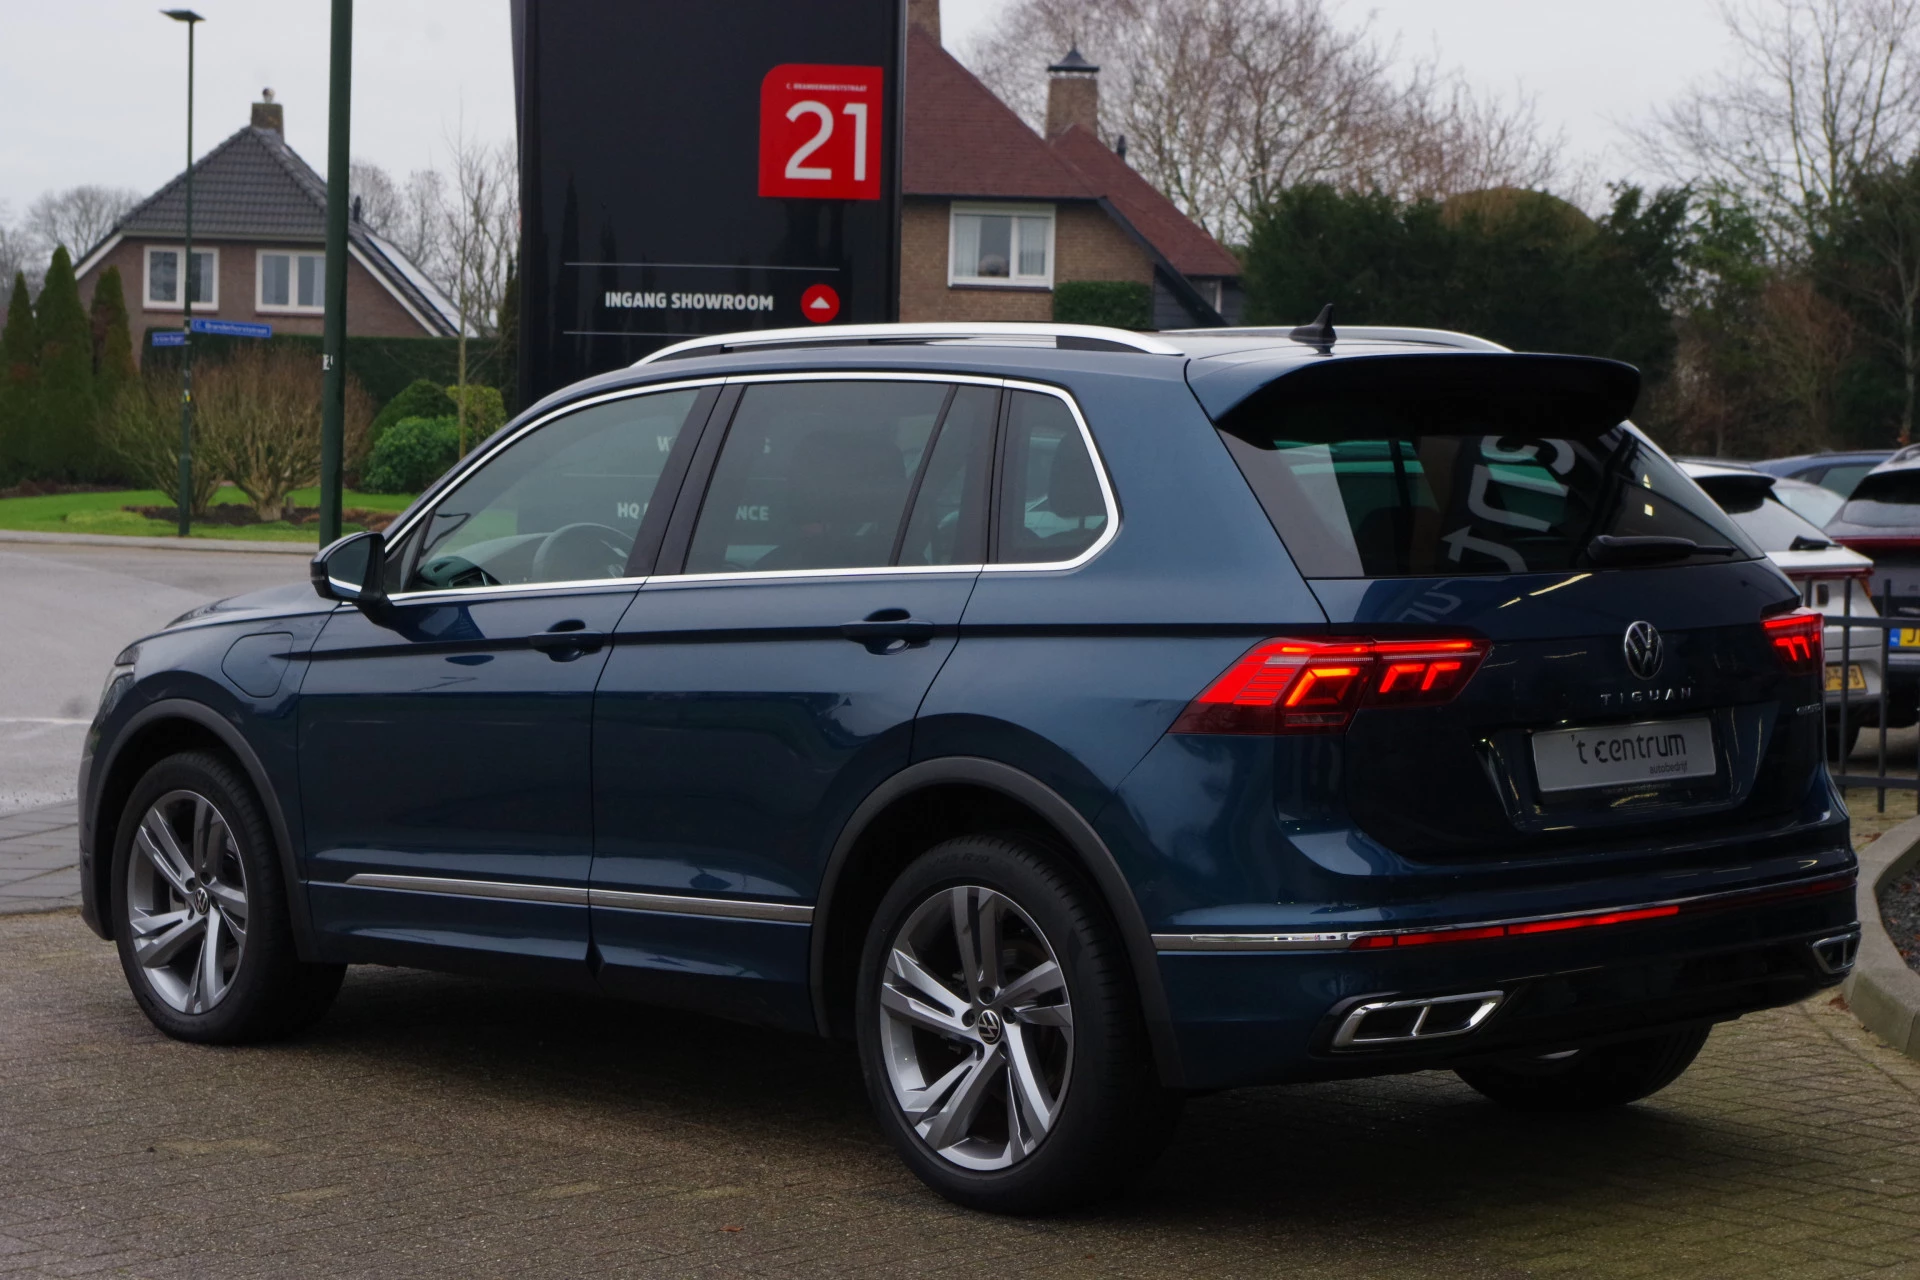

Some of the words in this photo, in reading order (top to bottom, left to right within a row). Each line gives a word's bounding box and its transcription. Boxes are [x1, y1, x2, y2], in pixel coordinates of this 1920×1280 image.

[785, 100, 868, 182] 21
[605, 292, 667, 309] INGANG
[671, 293, 774, 311] SHOWROOM
[1600, 687, 1692, 706] TIGUAN
[1595, 734, 1687, 763] centrum
